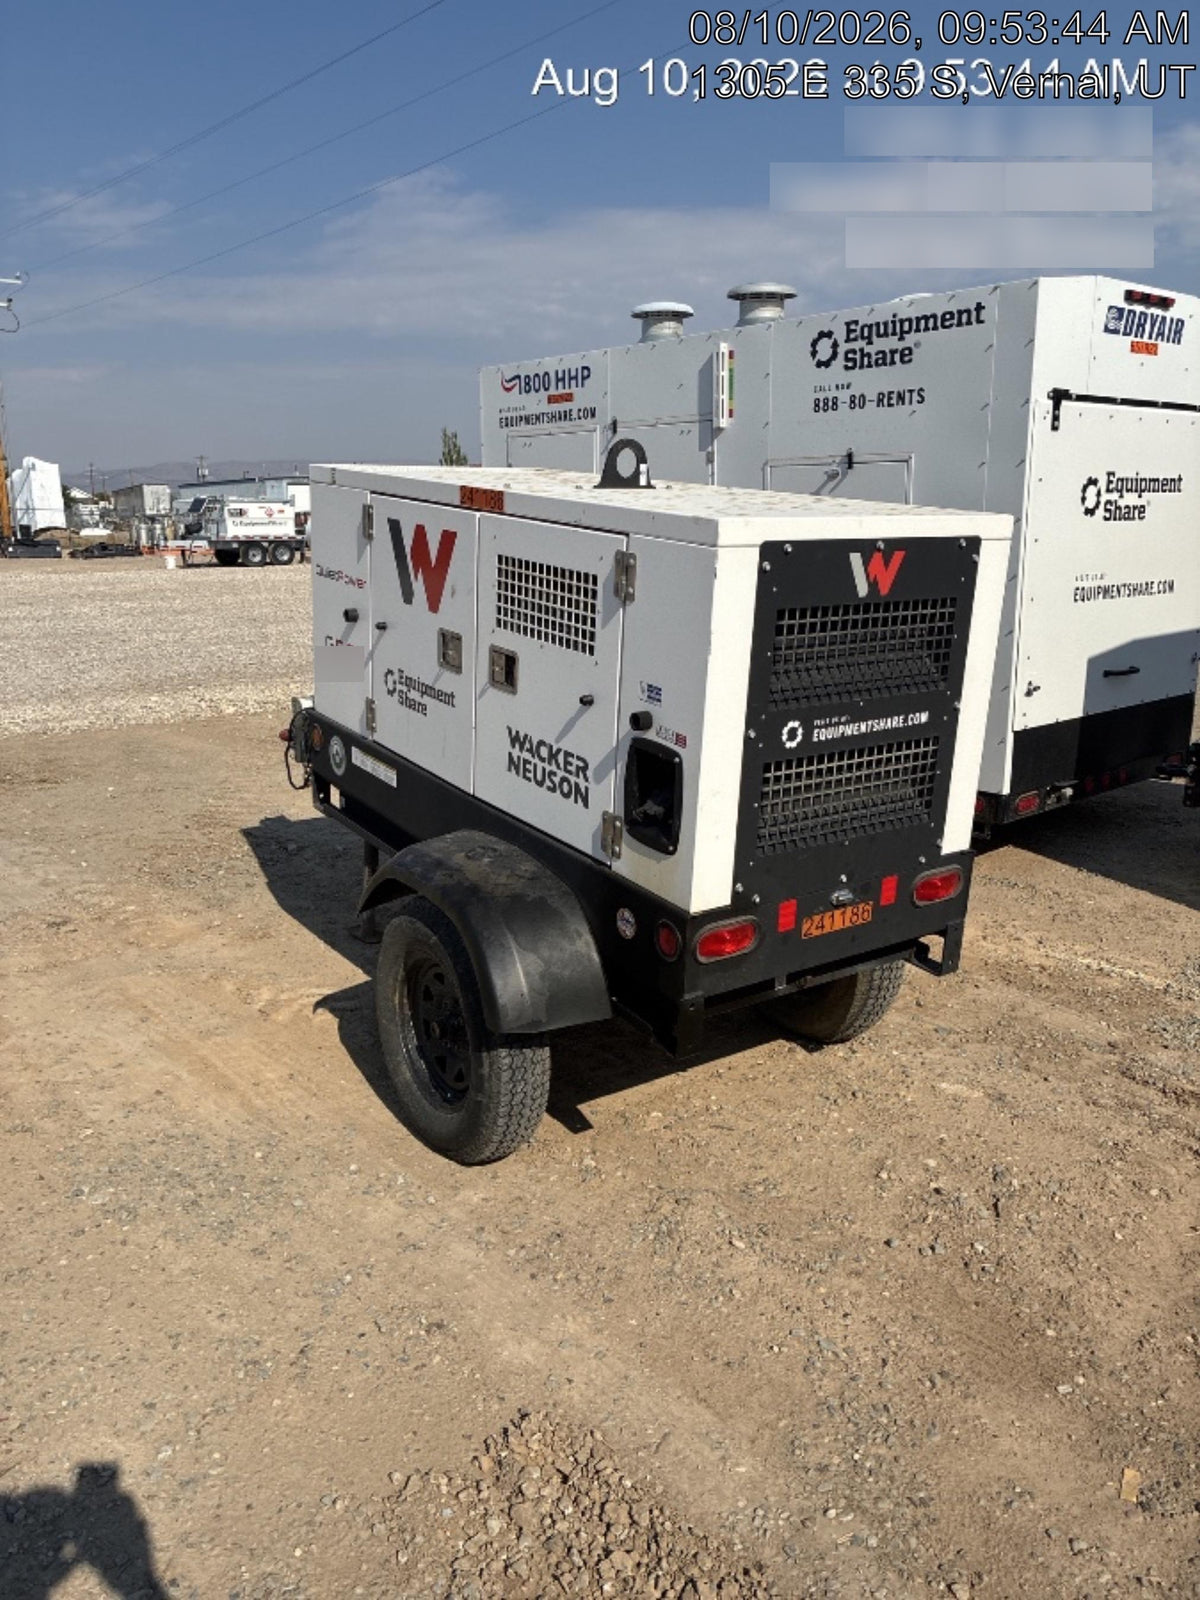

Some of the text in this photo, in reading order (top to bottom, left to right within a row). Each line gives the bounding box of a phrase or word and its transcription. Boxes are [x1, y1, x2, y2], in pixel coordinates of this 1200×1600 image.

[844, 302, 986, 346] Equipment
[1121, 308, 1185, 346] DRYAIR
[505, 366, 591, 395] 1800 HHP
[813, 387, 925, 413] 888-80-RENTS
[499, 407, 597, 429] EQUIPMENTSHARE.COM
[1105, 470, 1183, 499] Equipment
[1103, 499, 1146, 521] Share
[398, 668, 456, 708] Equipment
[812, 711, 929, 742] EQUIPMENTSHARE.COM
[506, 725, 590, 783] WACKER
[507, 752, 590, 809] NEUSON
[803, 902, 870, 937] 241186
